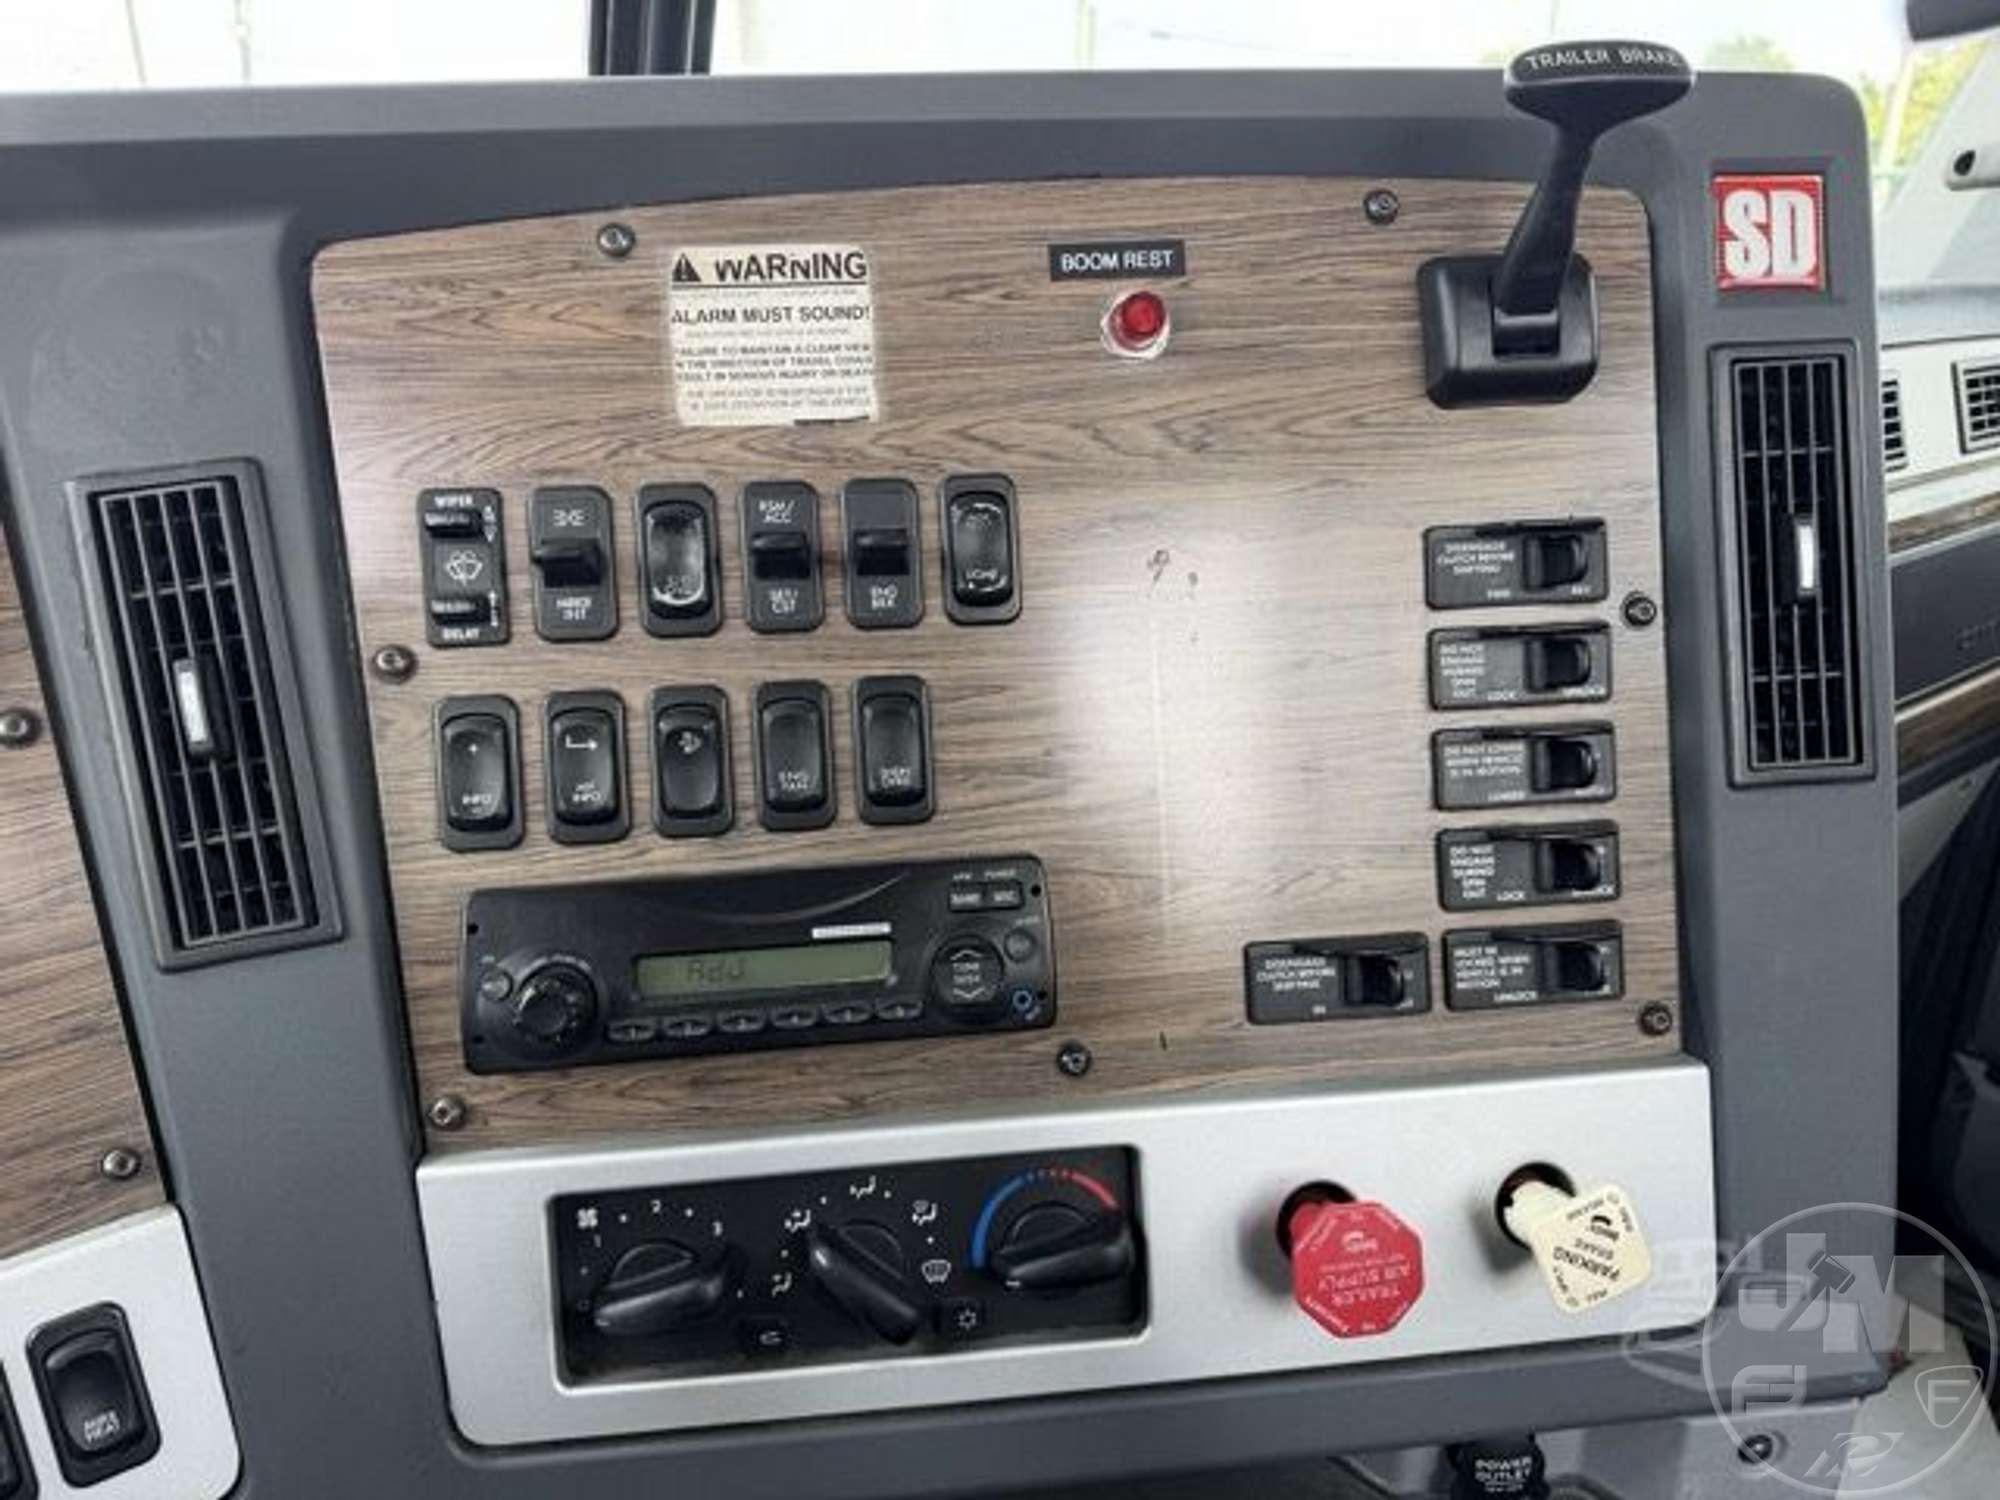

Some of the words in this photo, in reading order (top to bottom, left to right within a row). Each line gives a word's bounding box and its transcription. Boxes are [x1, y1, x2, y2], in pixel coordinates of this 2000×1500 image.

[1525, 49, 1610, 70] TRAILER
[1618, 48, 1682, 66] BRAKE
[1723, 189, 1818, 281] SD
[1061, 252, 1119, 273] BOOM
[1122, 249, 1174, 269] REST
[671, 309, 736, 323] ALARM
[743, 306, 793, 322] MUST
[799, 305, 871, 322] SOUND!
[434, 496, 473, 507] WIPER
